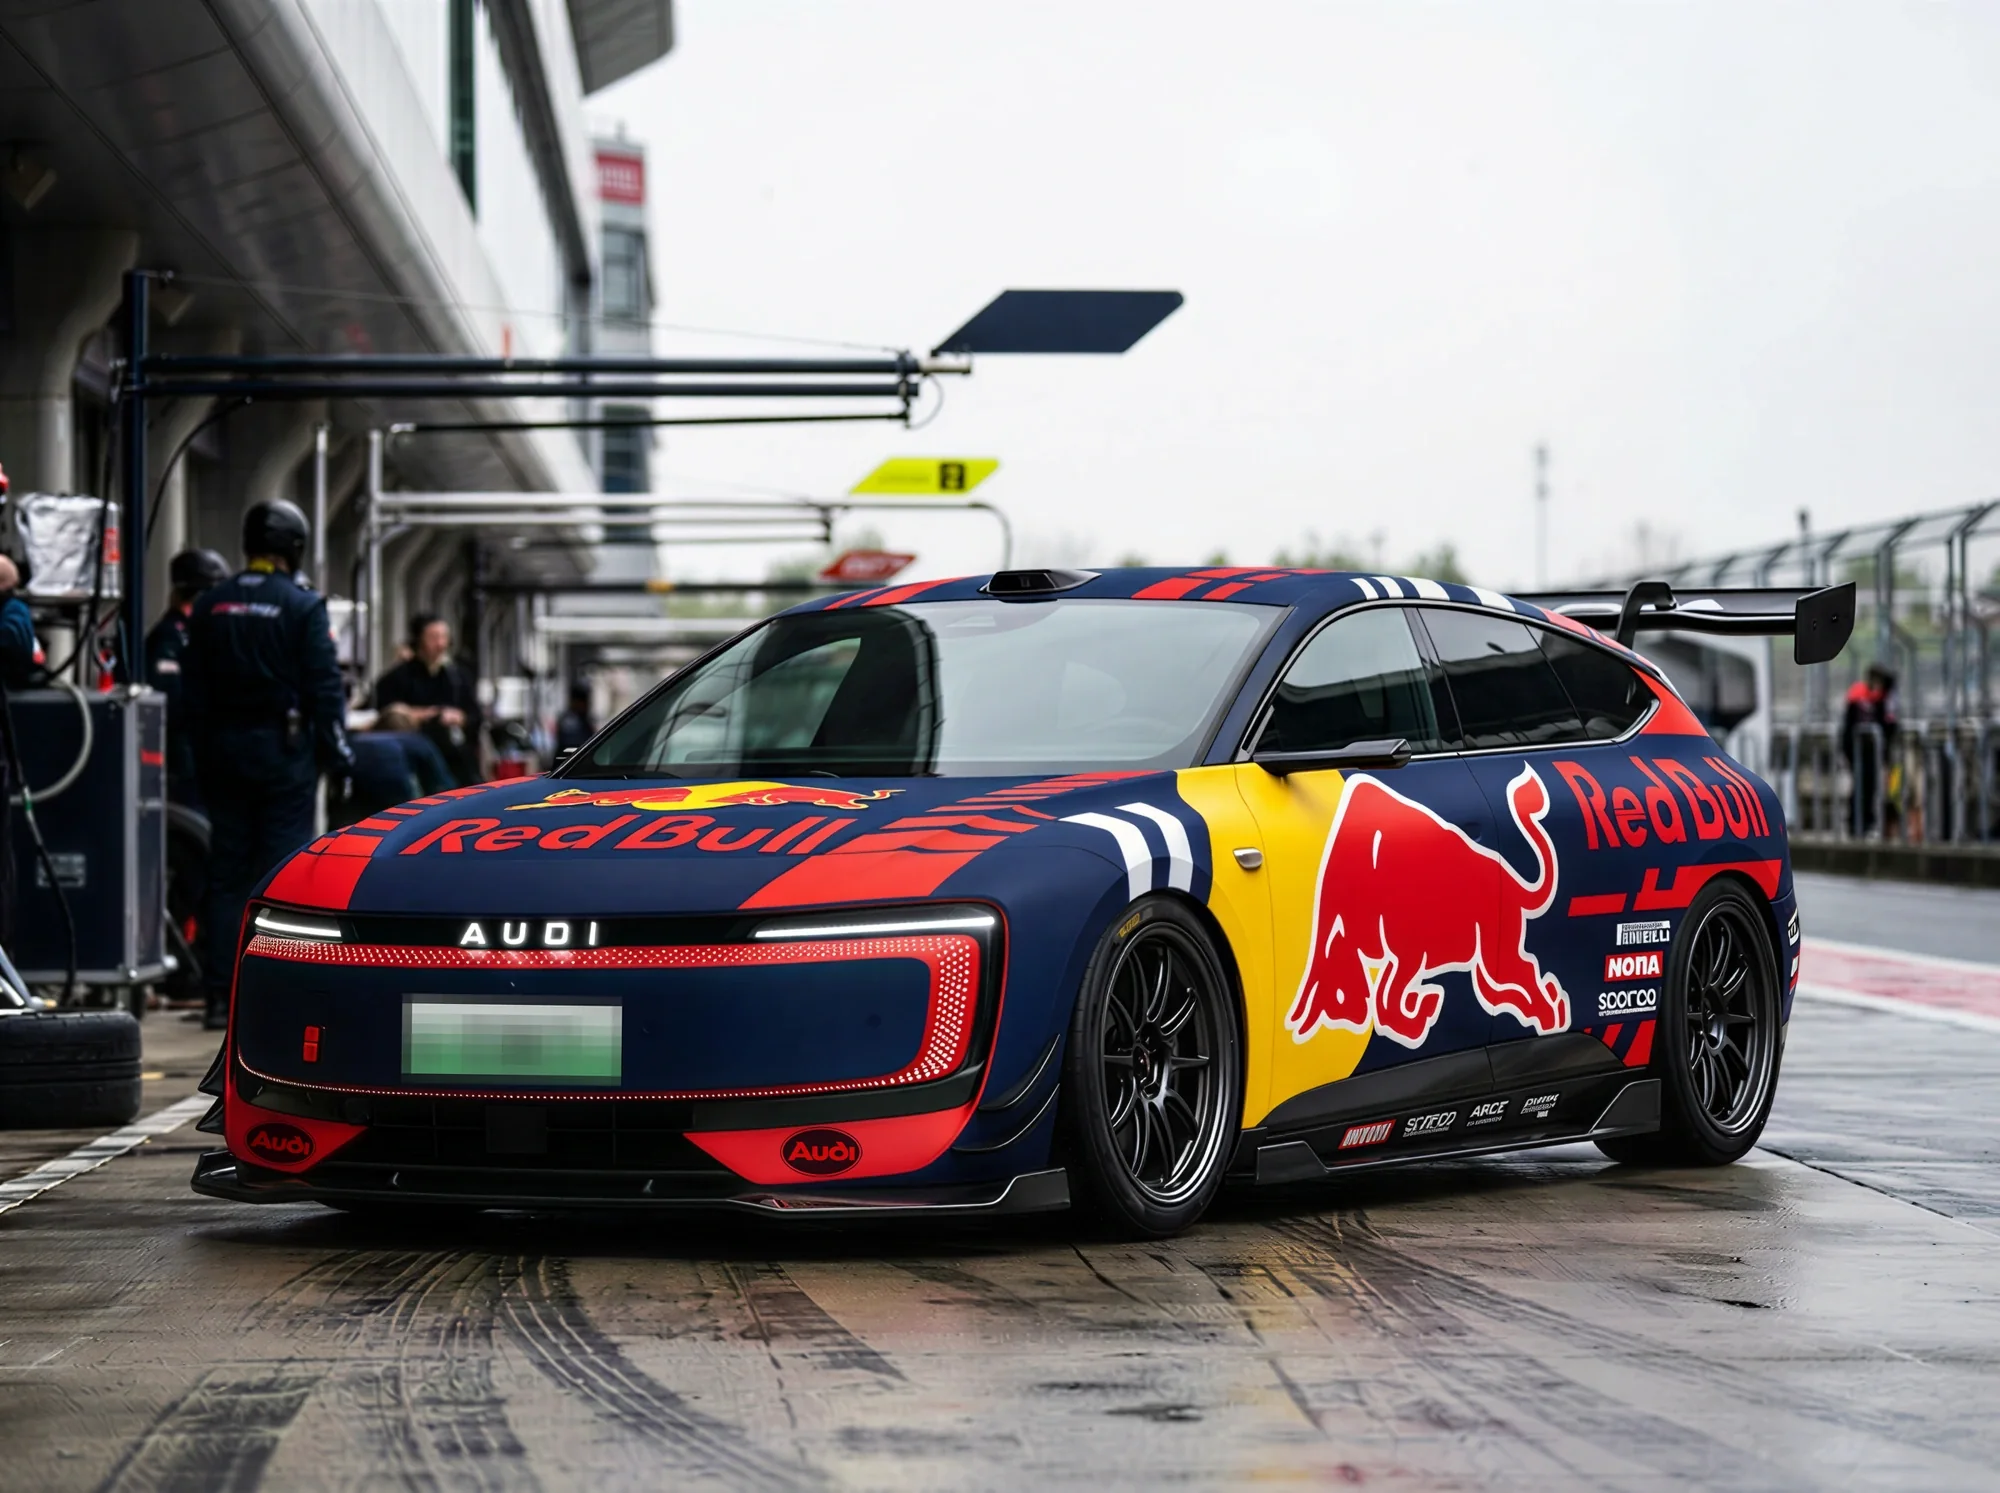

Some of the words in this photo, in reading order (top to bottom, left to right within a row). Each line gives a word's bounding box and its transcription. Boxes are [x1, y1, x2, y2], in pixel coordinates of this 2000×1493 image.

[1552, 756, 1687, 849] Red
[1652, 757, 1770, 840] Bull
[399, 815, 642, 855] Red
[613, 814, 858, 855] Bull
[460, 921, 597, 946] AUDI
[1469, 1100, 1509, 1118] ARCE
[250, 1130, 311, 1156] Audi
[787, 1141, 856, 1162] Audi
